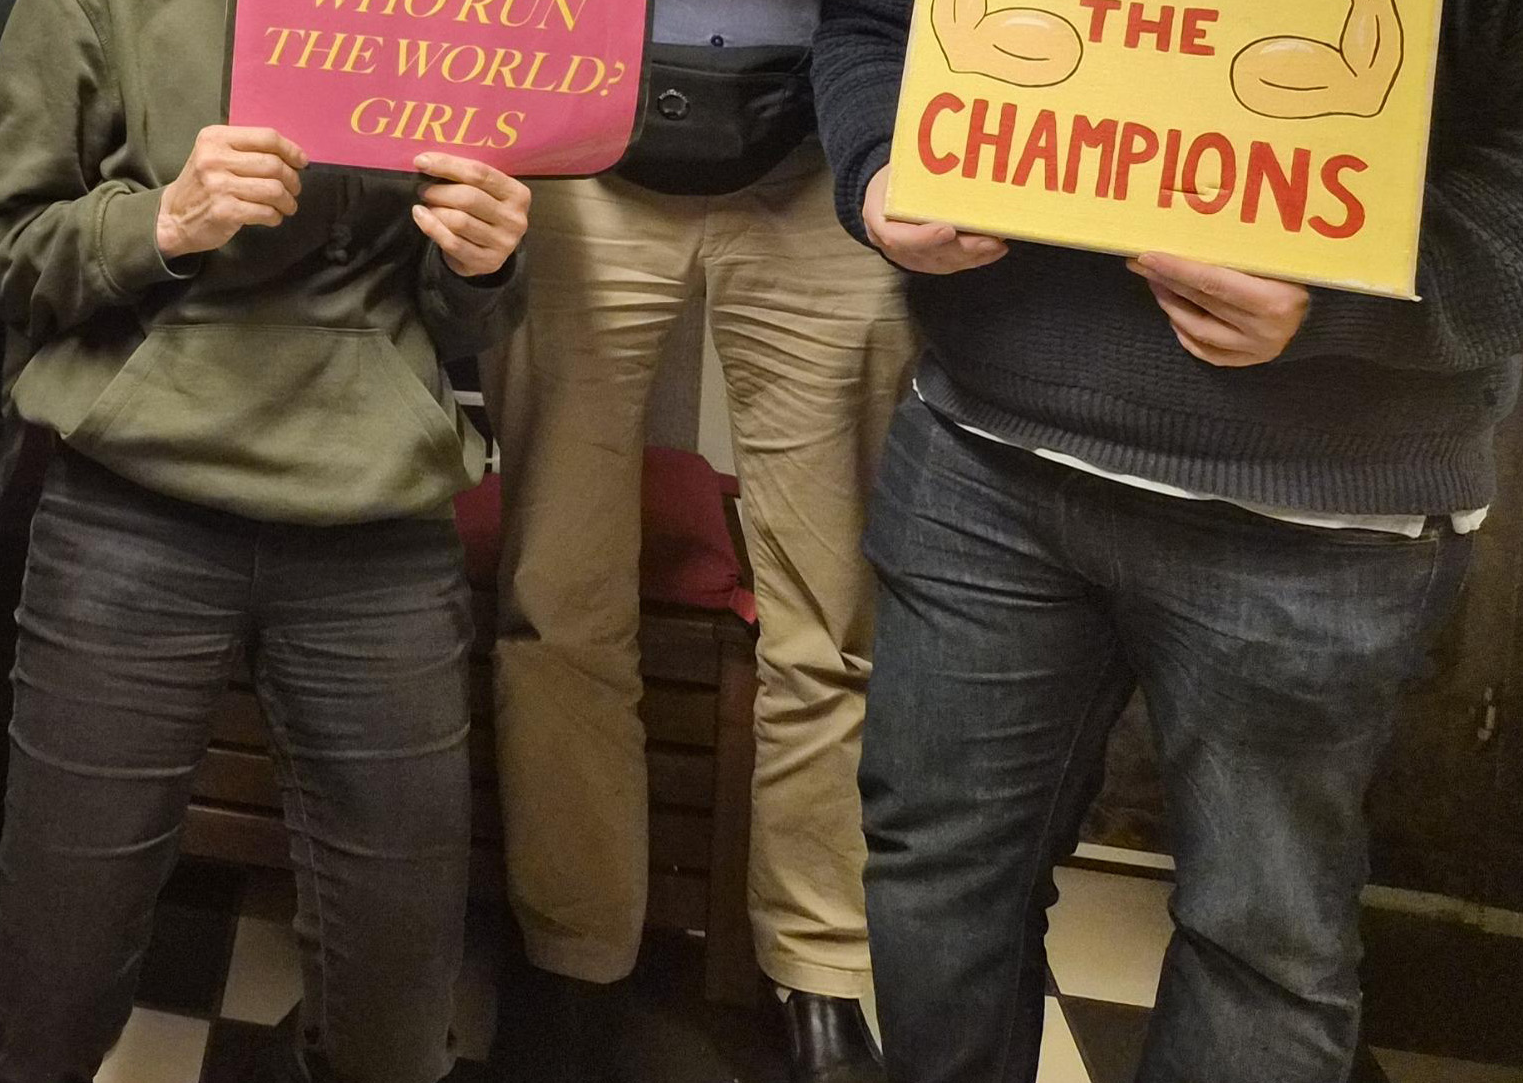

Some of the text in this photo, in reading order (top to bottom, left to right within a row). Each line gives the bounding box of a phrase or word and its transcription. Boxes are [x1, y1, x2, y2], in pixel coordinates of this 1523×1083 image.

[264, 26, 626, 98] THE WORLD?
[350, 96, 527, 150] GIRLS
[917, 92, 1370, 239] CHAMPIONS
